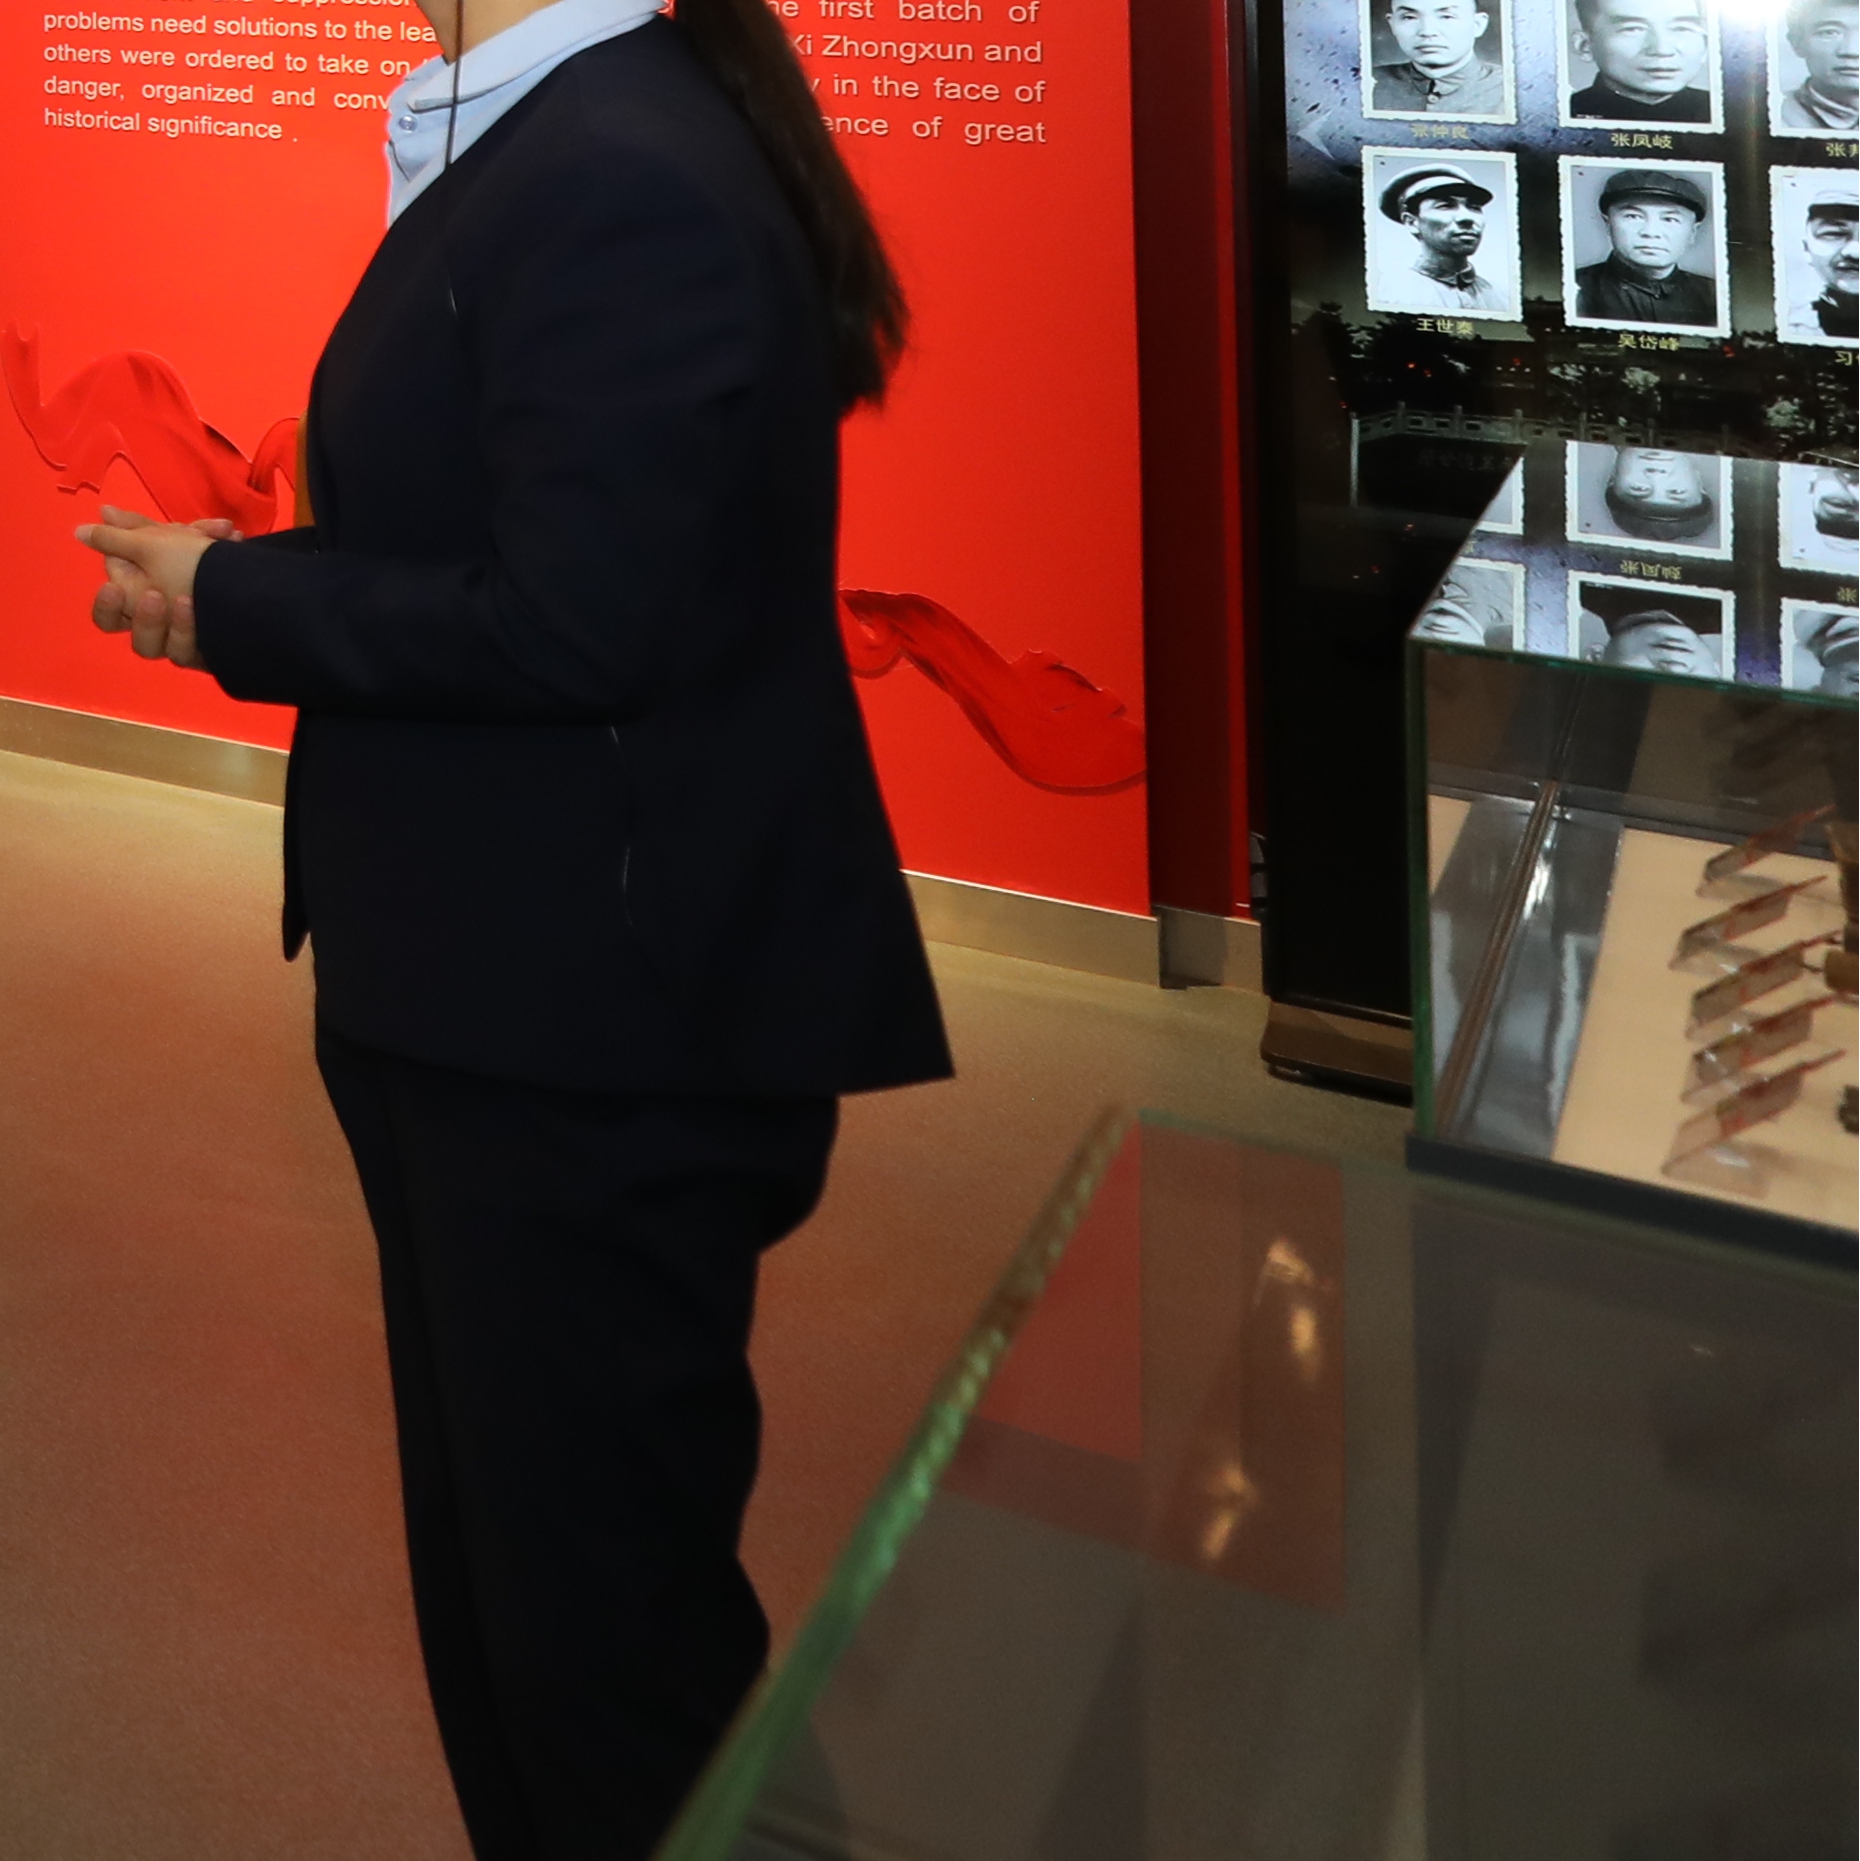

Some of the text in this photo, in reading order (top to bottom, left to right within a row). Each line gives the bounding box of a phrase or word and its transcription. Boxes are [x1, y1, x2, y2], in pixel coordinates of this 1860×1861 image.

[1009, 1, 1040, 23] of
[43, 12, 144, 33] problems
[151, 15, 206, 34] need
[213, 17, 317, 38] solutions
[325, 20, 347, 39] to
[354, 20, 391, 41] the
[822, 35, 974, 64] Zhongxun
[984, 40, 1042, 63] and
[43, 45, 1046, 103] others were ordered to take on in the face of
[43, 76, 125, 101] danger,
[141, 81, 253, 110] organized
[272, 88, 315, 108] and
[334, 92, 389, 111] conv
[912, 116, 943, 138] of
[965, 120, 1046, 145] great
[43, 109, 282, 141] historical significance
[1835, 349, 1860, 367] 习
